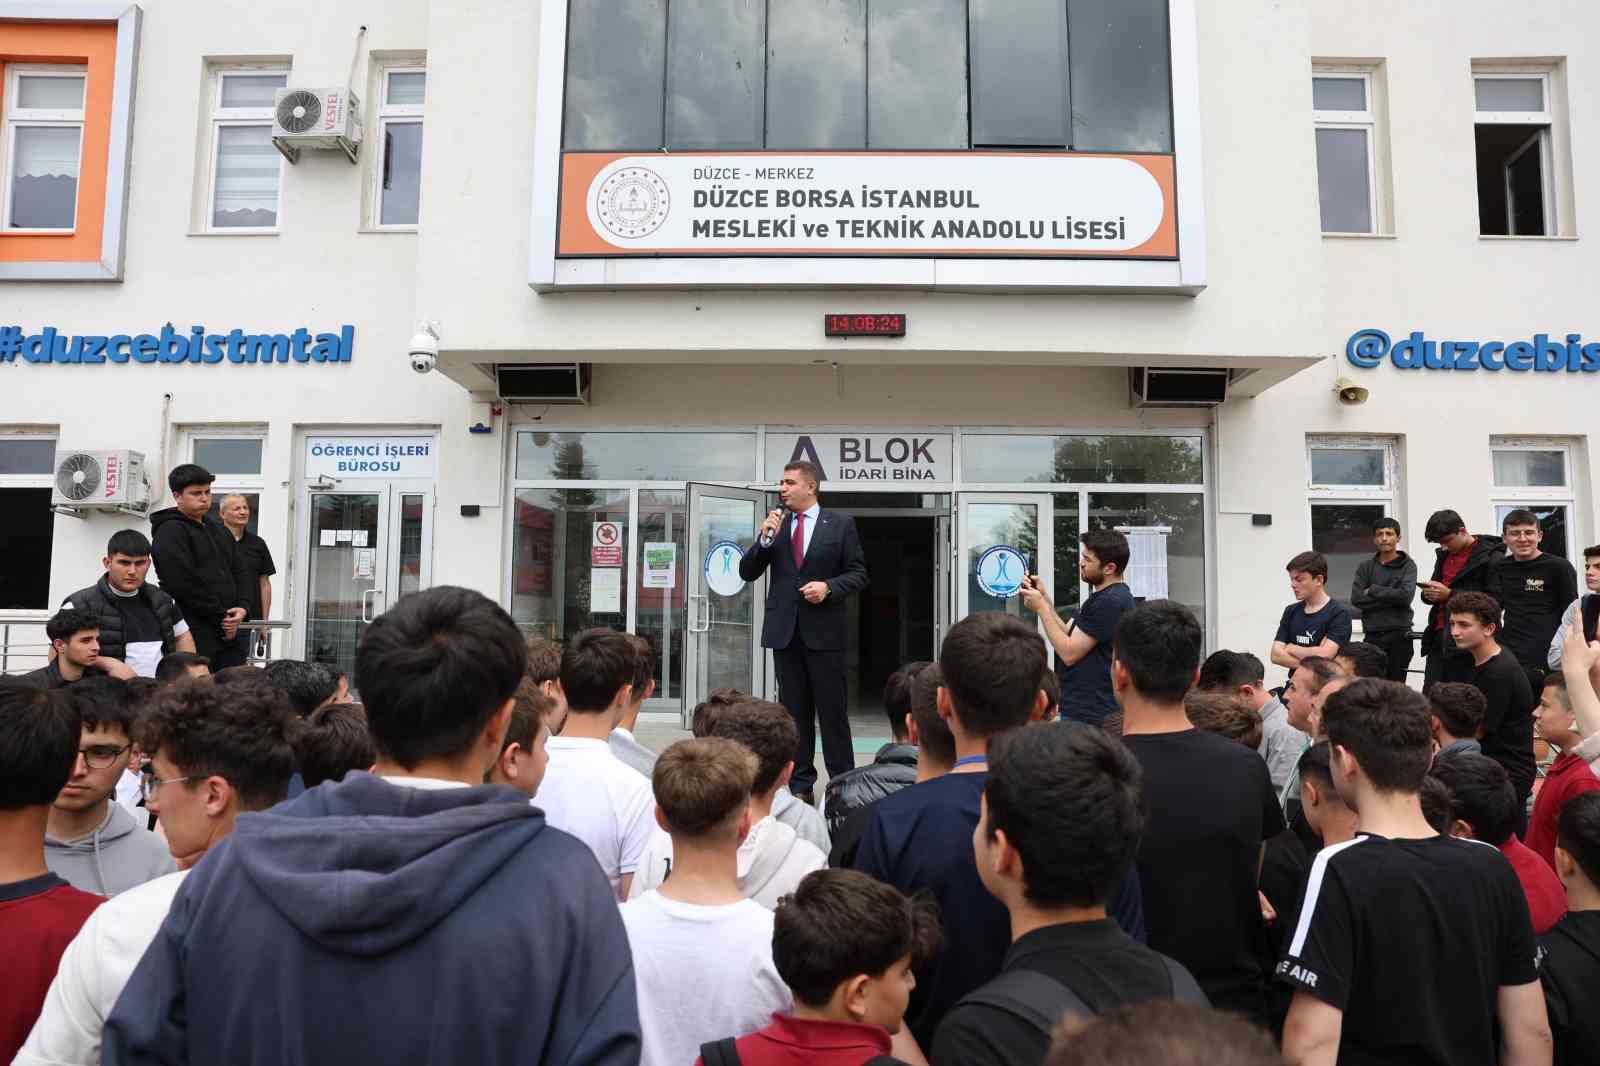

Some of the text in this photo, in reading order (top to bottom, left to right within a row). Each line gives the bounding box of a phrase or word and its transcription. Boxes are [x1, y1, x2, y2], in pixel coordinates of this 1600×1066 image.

[325, 93, 338, 131] VESTEL
[693, 166, 741, 180] DÜZCE
[755, 167, 815, 180] MERKEZ
[693, 185, 980, 209] DÜZCE BORSA İSTANBUL
[692, 214, 1126, 240] MESLEKİ ve TEKNİK ANADOLU LİSESİ
[311, 442, 429, 458] ÖĞRENCİ İŞLERİ
[787, 436, 936, 481] A BLOK
[104, 455, 118, 498] VESTEL
[338, 458, 401, 472] BÜROSU
[839, 466, 936, 480] İDARİ BİNA
[1289, 964, 1318, 987] AIR
